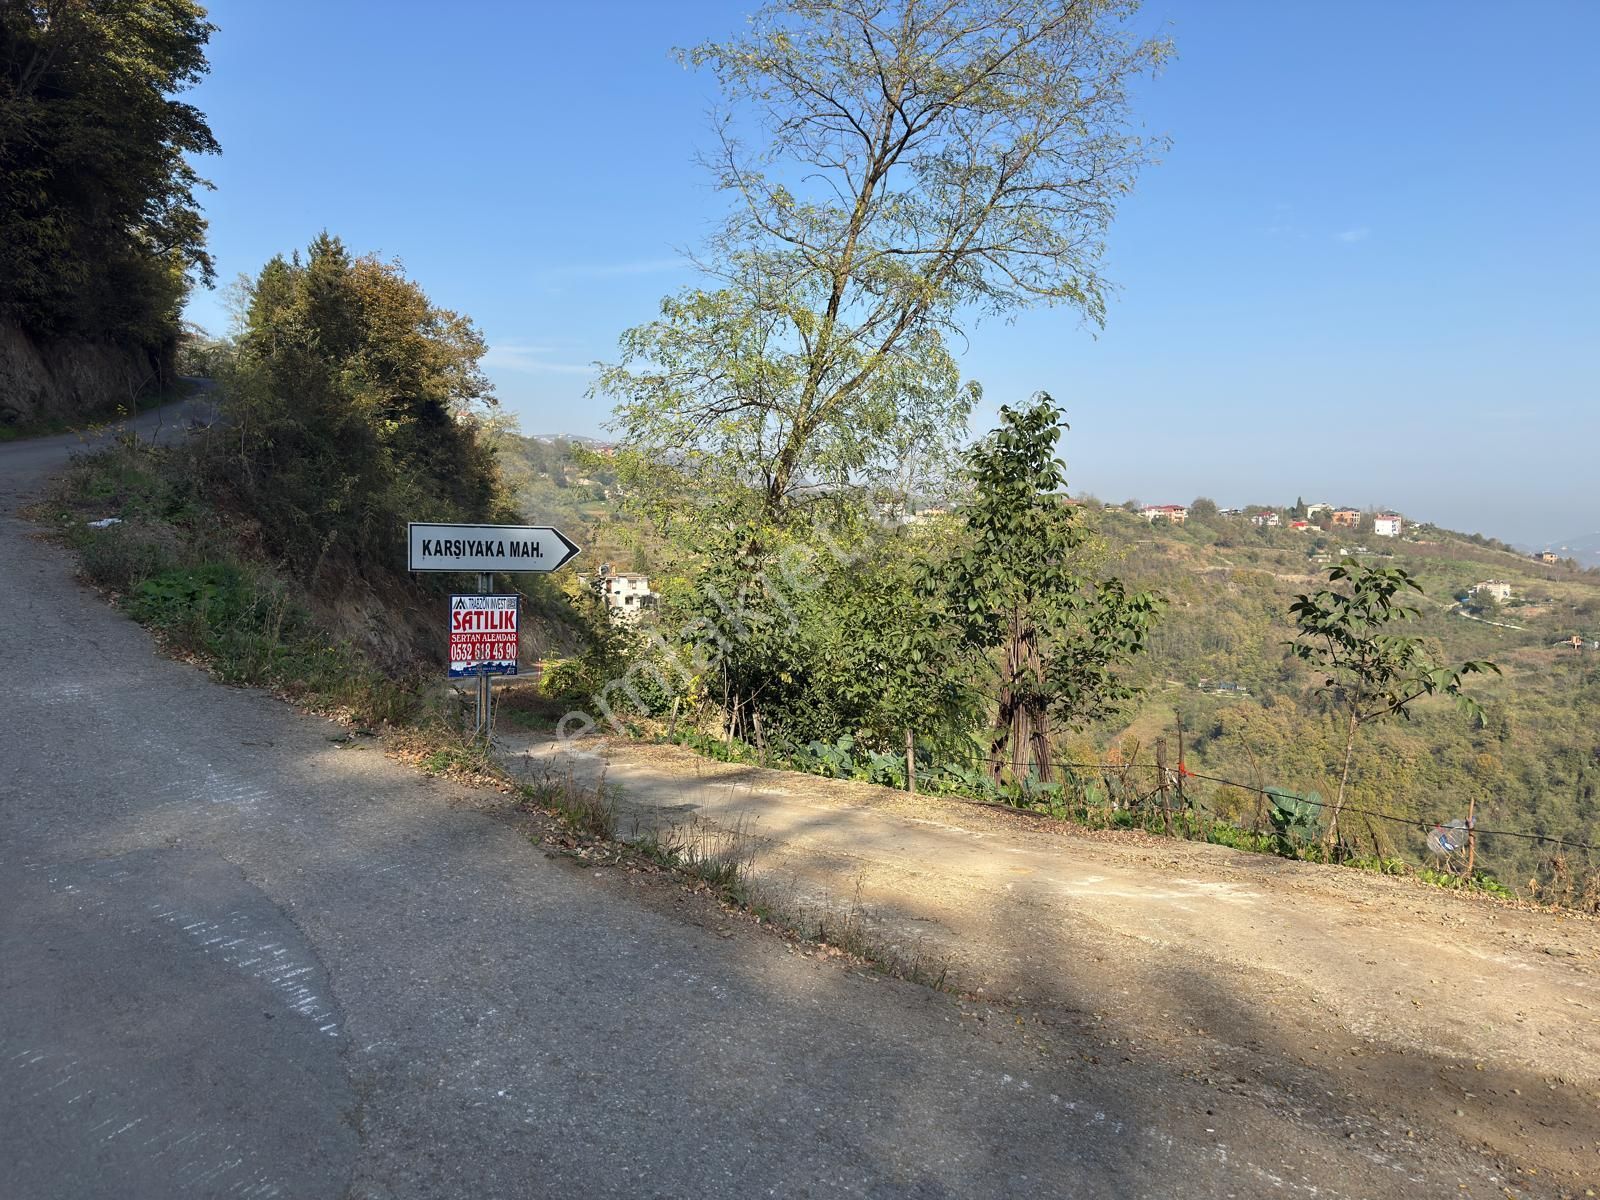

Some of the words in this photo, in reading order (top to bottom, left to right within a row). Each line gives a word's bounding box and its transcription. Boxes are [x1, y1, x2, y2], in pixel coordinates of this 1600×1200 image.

[422, 539, 505, 560] KARŞIYAKA
[509, 541, 544, 558] MAH.
[453, 611, 515, 631] SATILIK
[451, 634, 481, 643] SERTAN
[482, 633, 517, 642] ALEMDAR
[451, 643, 472, 660] 0532
[474, 642, 491, 659] 618
[505, 642, 517, 659] 90
